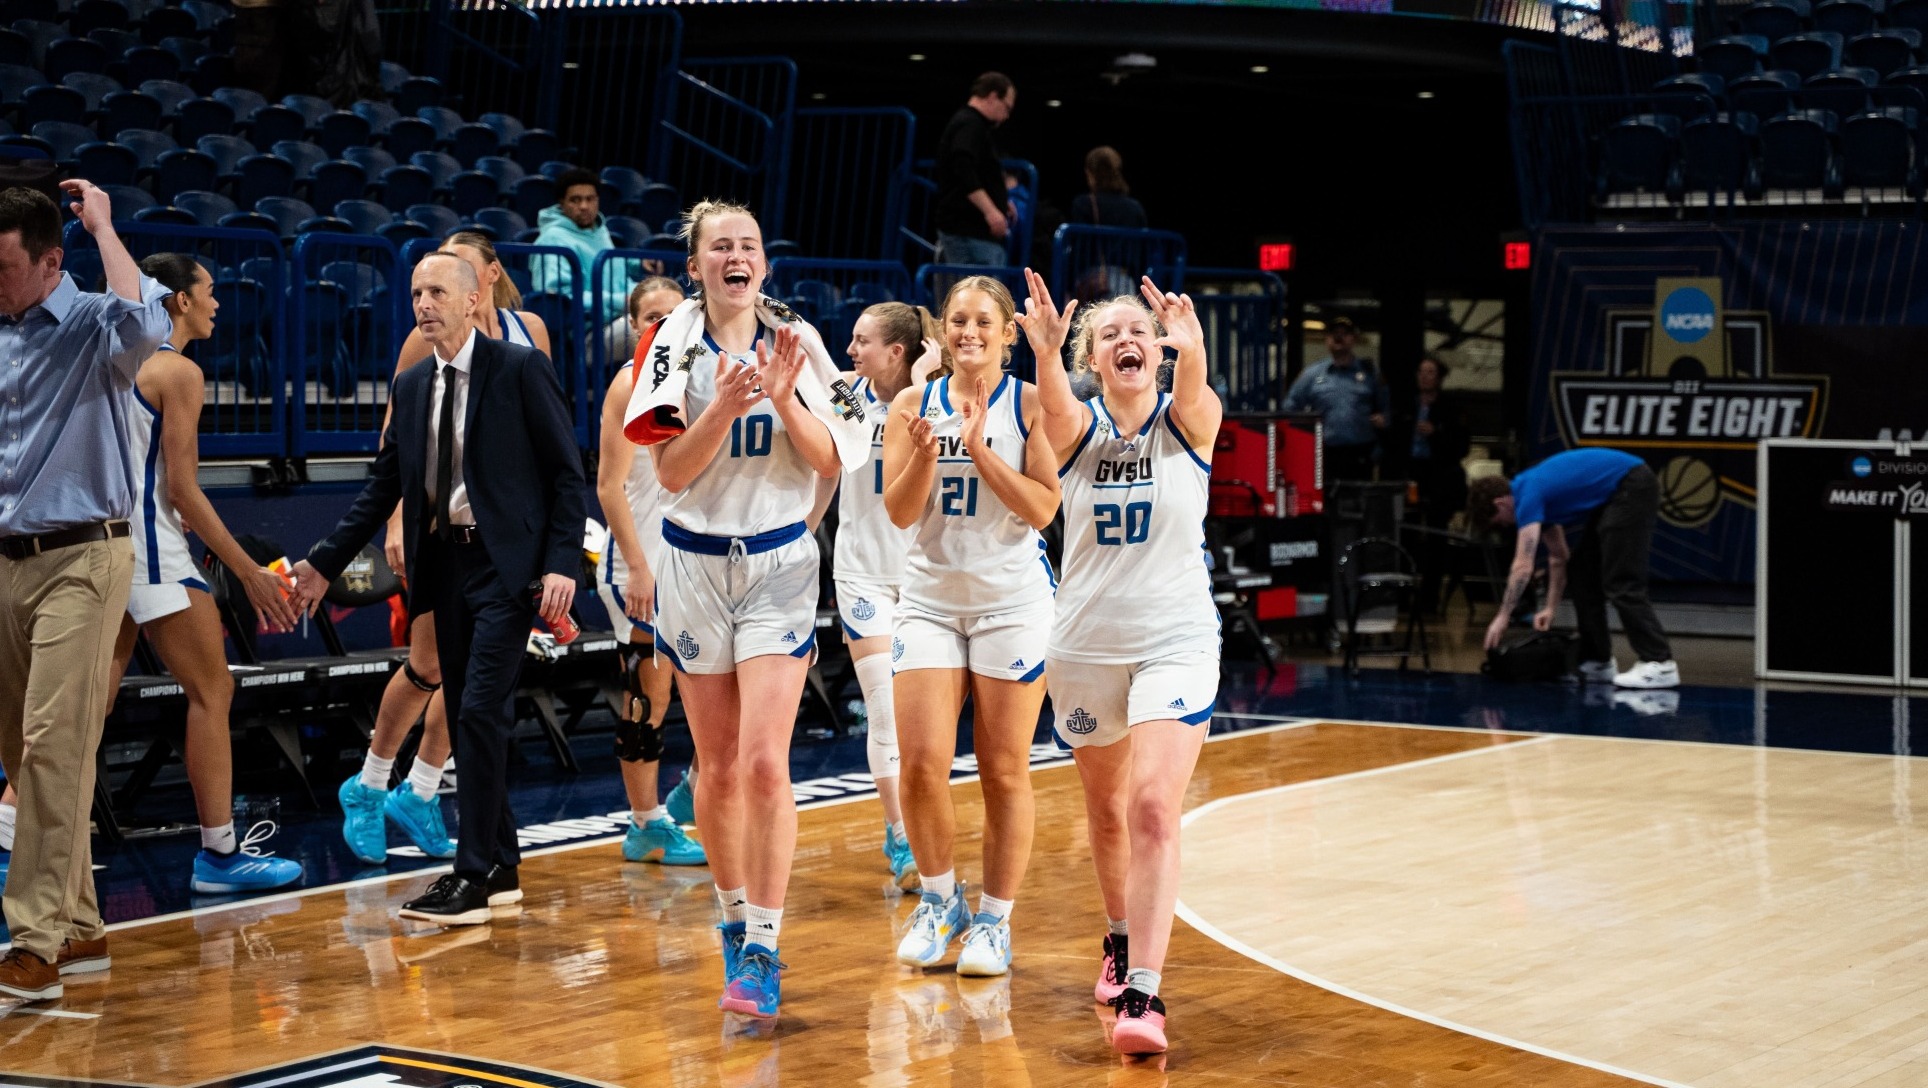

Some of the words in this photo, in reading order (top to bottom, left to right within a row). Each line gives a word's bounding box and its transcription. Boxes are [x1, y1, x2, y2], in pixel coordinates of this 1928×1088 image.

[1666, 313, 1714, 330] NCAA
[1581, 395, 1682, 435] ELITE
[1687, 397, 1803, 437] EIGHT
[731, 414, 773, 458] 10
[938, 436, 992, 457] GV
[1095, 457, 1153, 483] GVSU
[1878, 461, 1928, 475] DIVISIO
[942, 477, 978, 517] 21
[1829, 489, 1878, 506] MAKE
[1881, 491, 1898, 506] IT
[1094, 501, 1152, 546] 20
[241, 674, 277, 688] CHAMPIONS
[289, 670, 306, 682] HERE
[140, 684, 178, 698] CHAMPIONS
